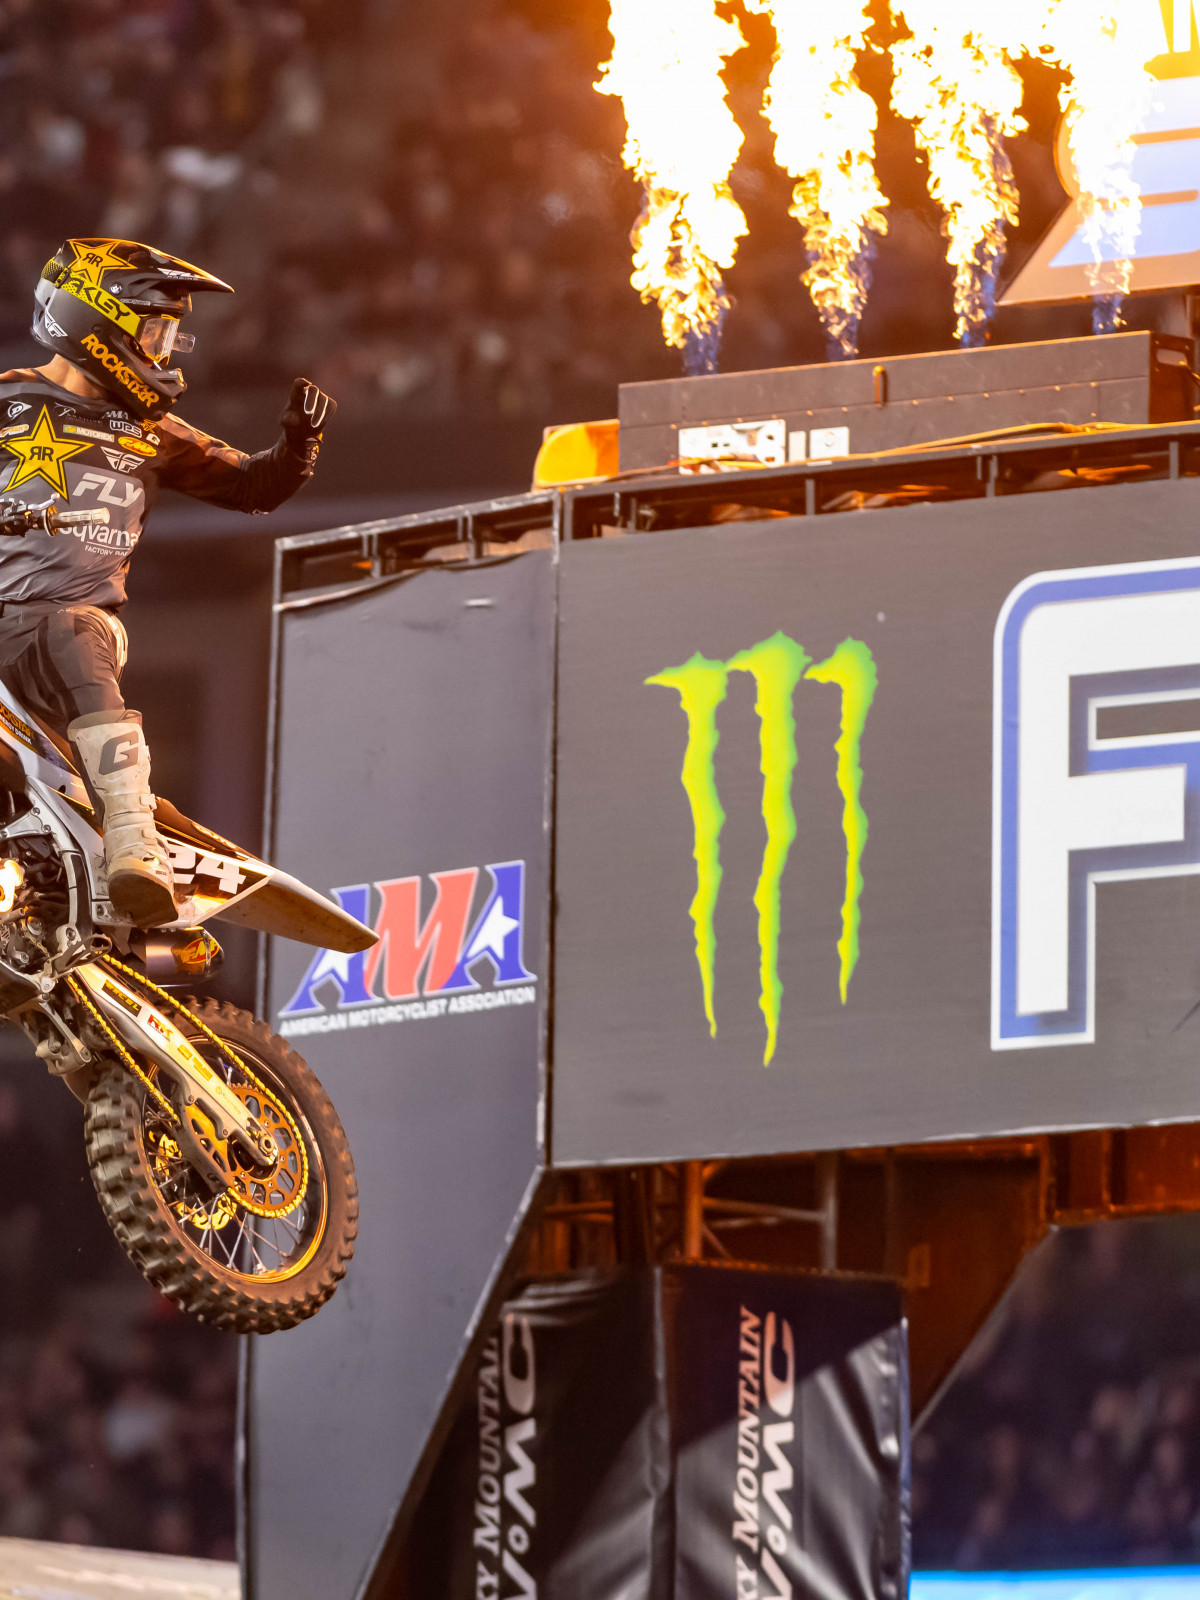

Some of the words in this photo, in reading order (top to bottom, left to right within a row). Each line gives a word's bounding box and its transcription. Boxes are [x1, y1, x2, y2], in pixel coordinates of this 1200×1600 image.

[62, 277, 130, 321] AKLEY
[81, 333, 159, 408] ROCKSTAR
[110, 420, 142, 438] WPS
[72, 472, 144, 507] FLY
[60, 523, 140, 547] sqvarna
[84, 545, 113, 556] FACTORY
[278, 860, 538, 1018] AMA
[278, 1012, 348, 1036] AMERICAN
[349, 1000, 448, 1027] MOTORCYCLIST
[449, 986, 536, 1013] ASSOCIATION
[473, 1335, 500, 1556] MOUNTAI
[732, 1304, 761, 1553] MOUNTAIN
